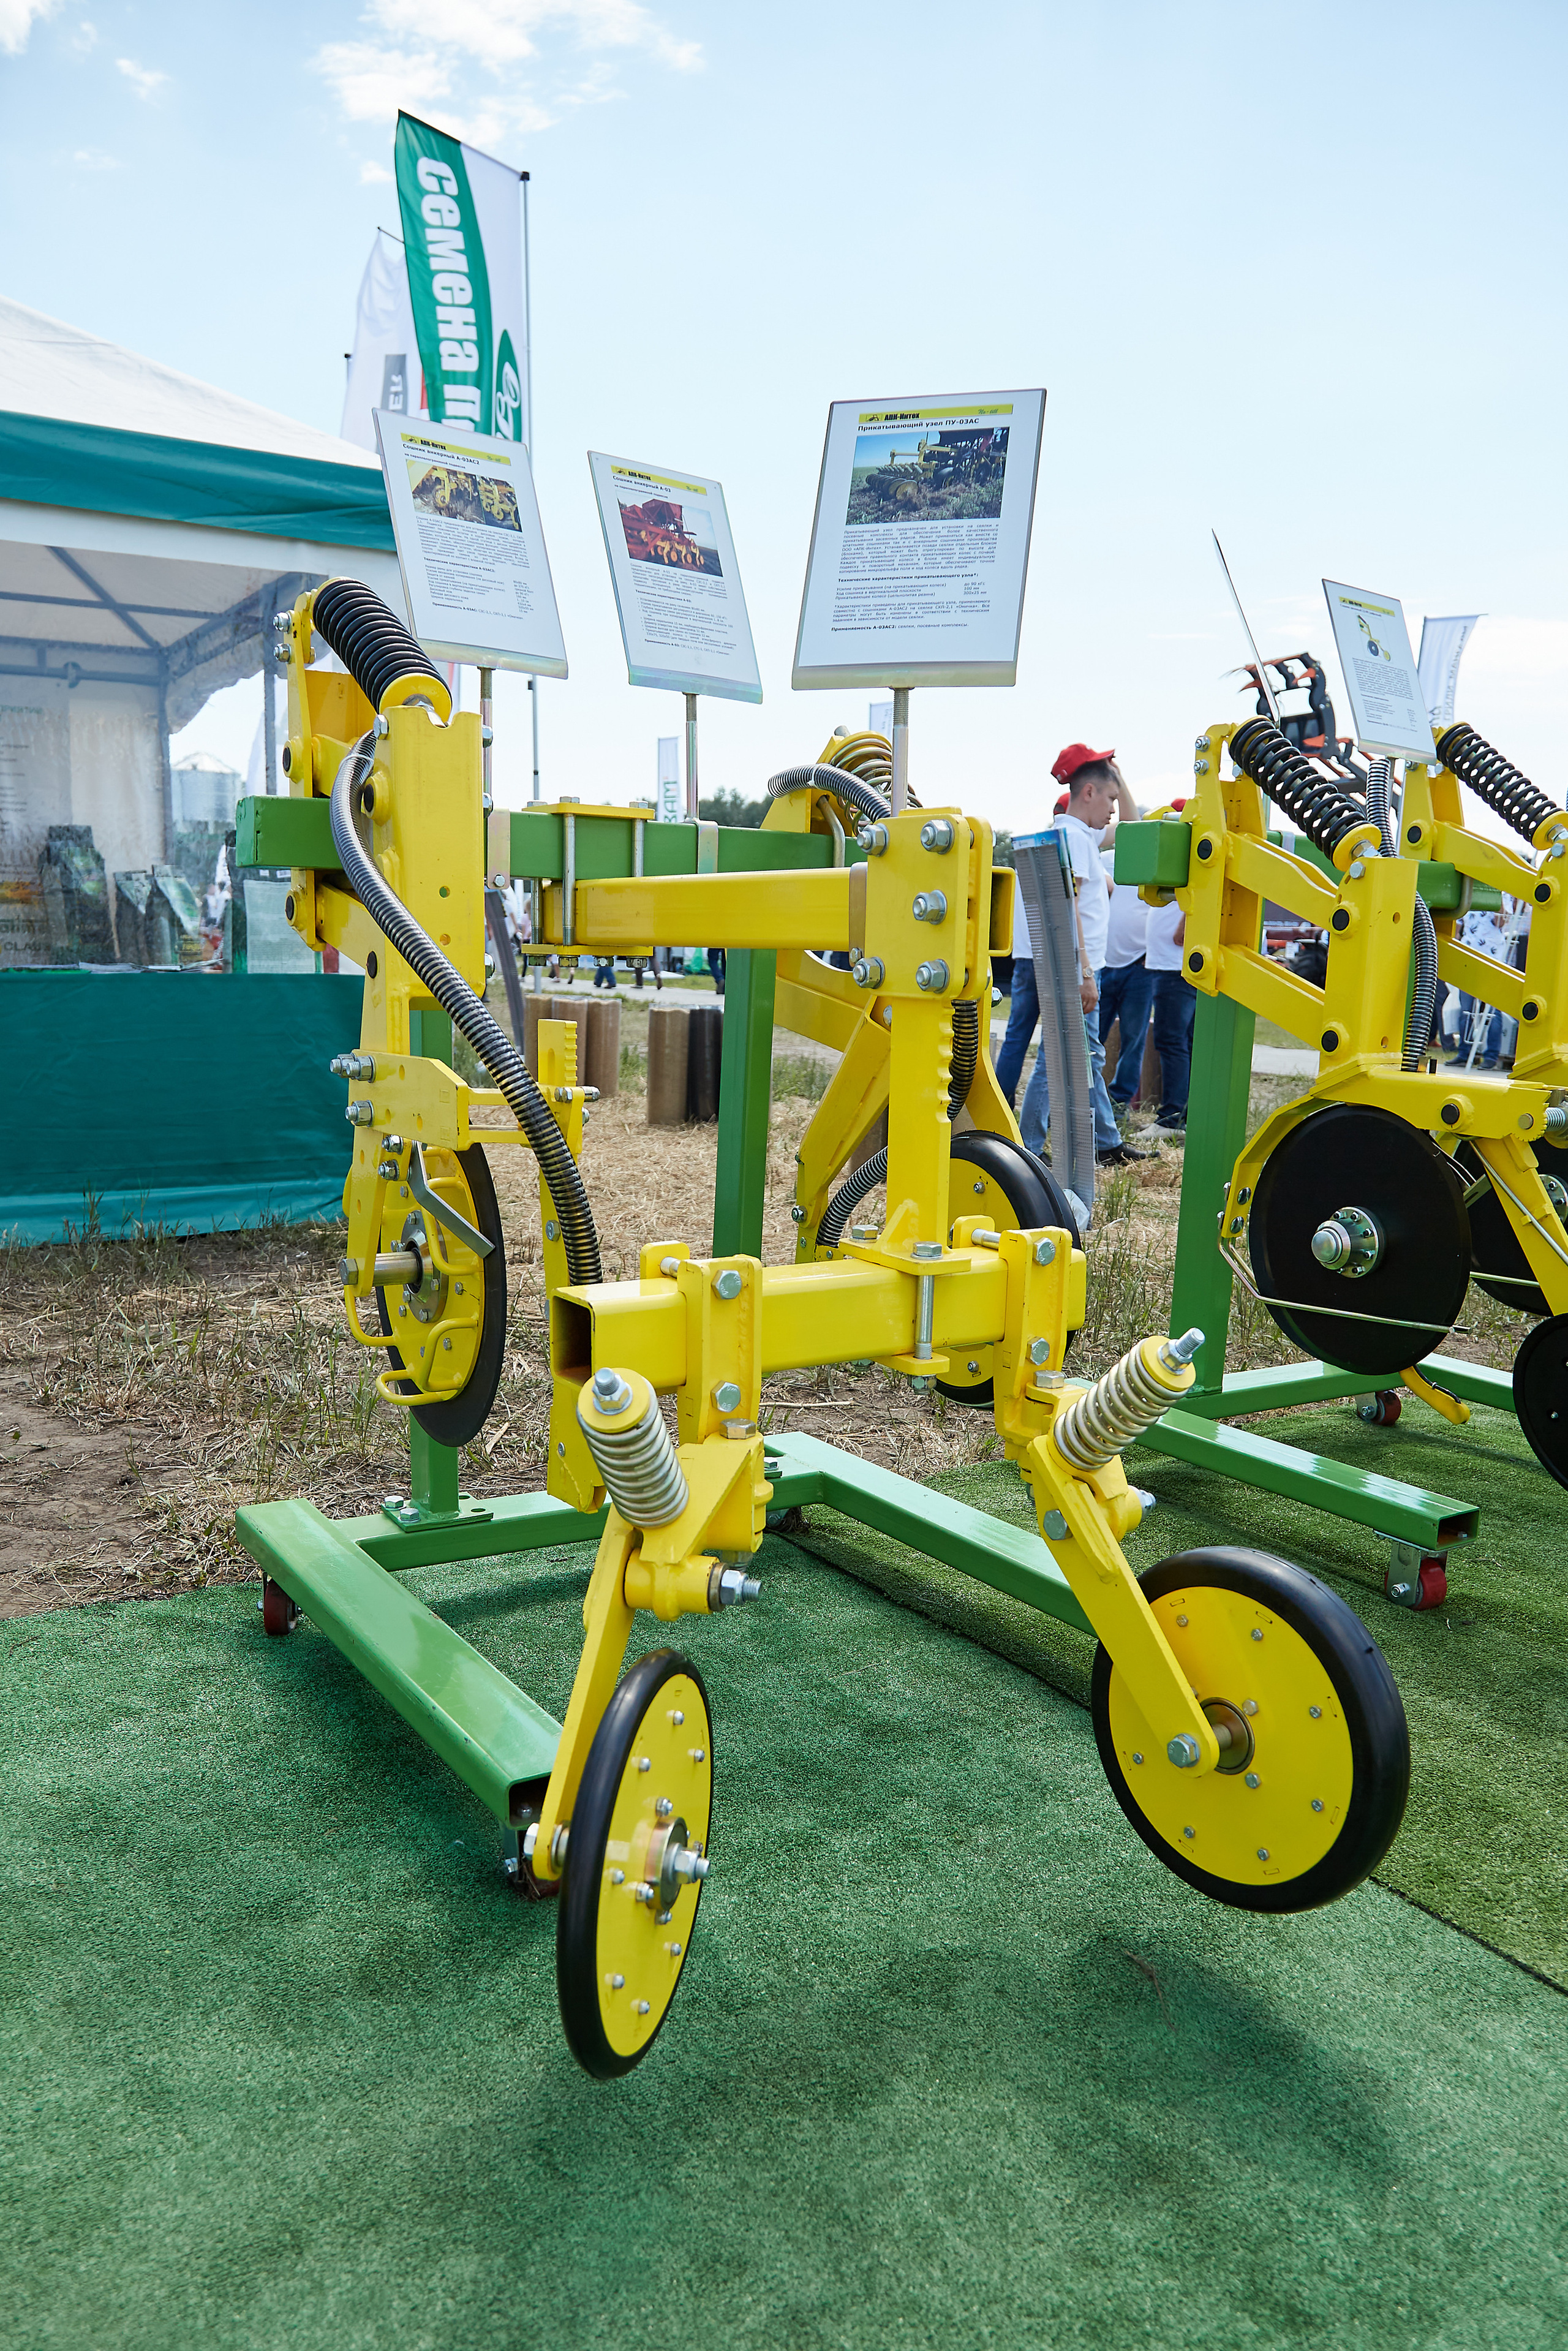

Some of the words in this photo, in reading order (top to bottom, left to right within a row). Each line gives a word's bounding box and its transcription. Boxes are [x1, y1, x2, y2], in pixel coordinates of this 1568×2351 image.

[443, 383, 482, 431] П
[884, 412, 919, 420] АПК-Интех
[858, 421, 923, 432] Прикатывающий
[402, 443, 425, 452] Сошник
[426, 448, 454, 459] анкерный
[456, 455, 479, 464] А-03АС2
[633, 480, 658, 490] анкерный
